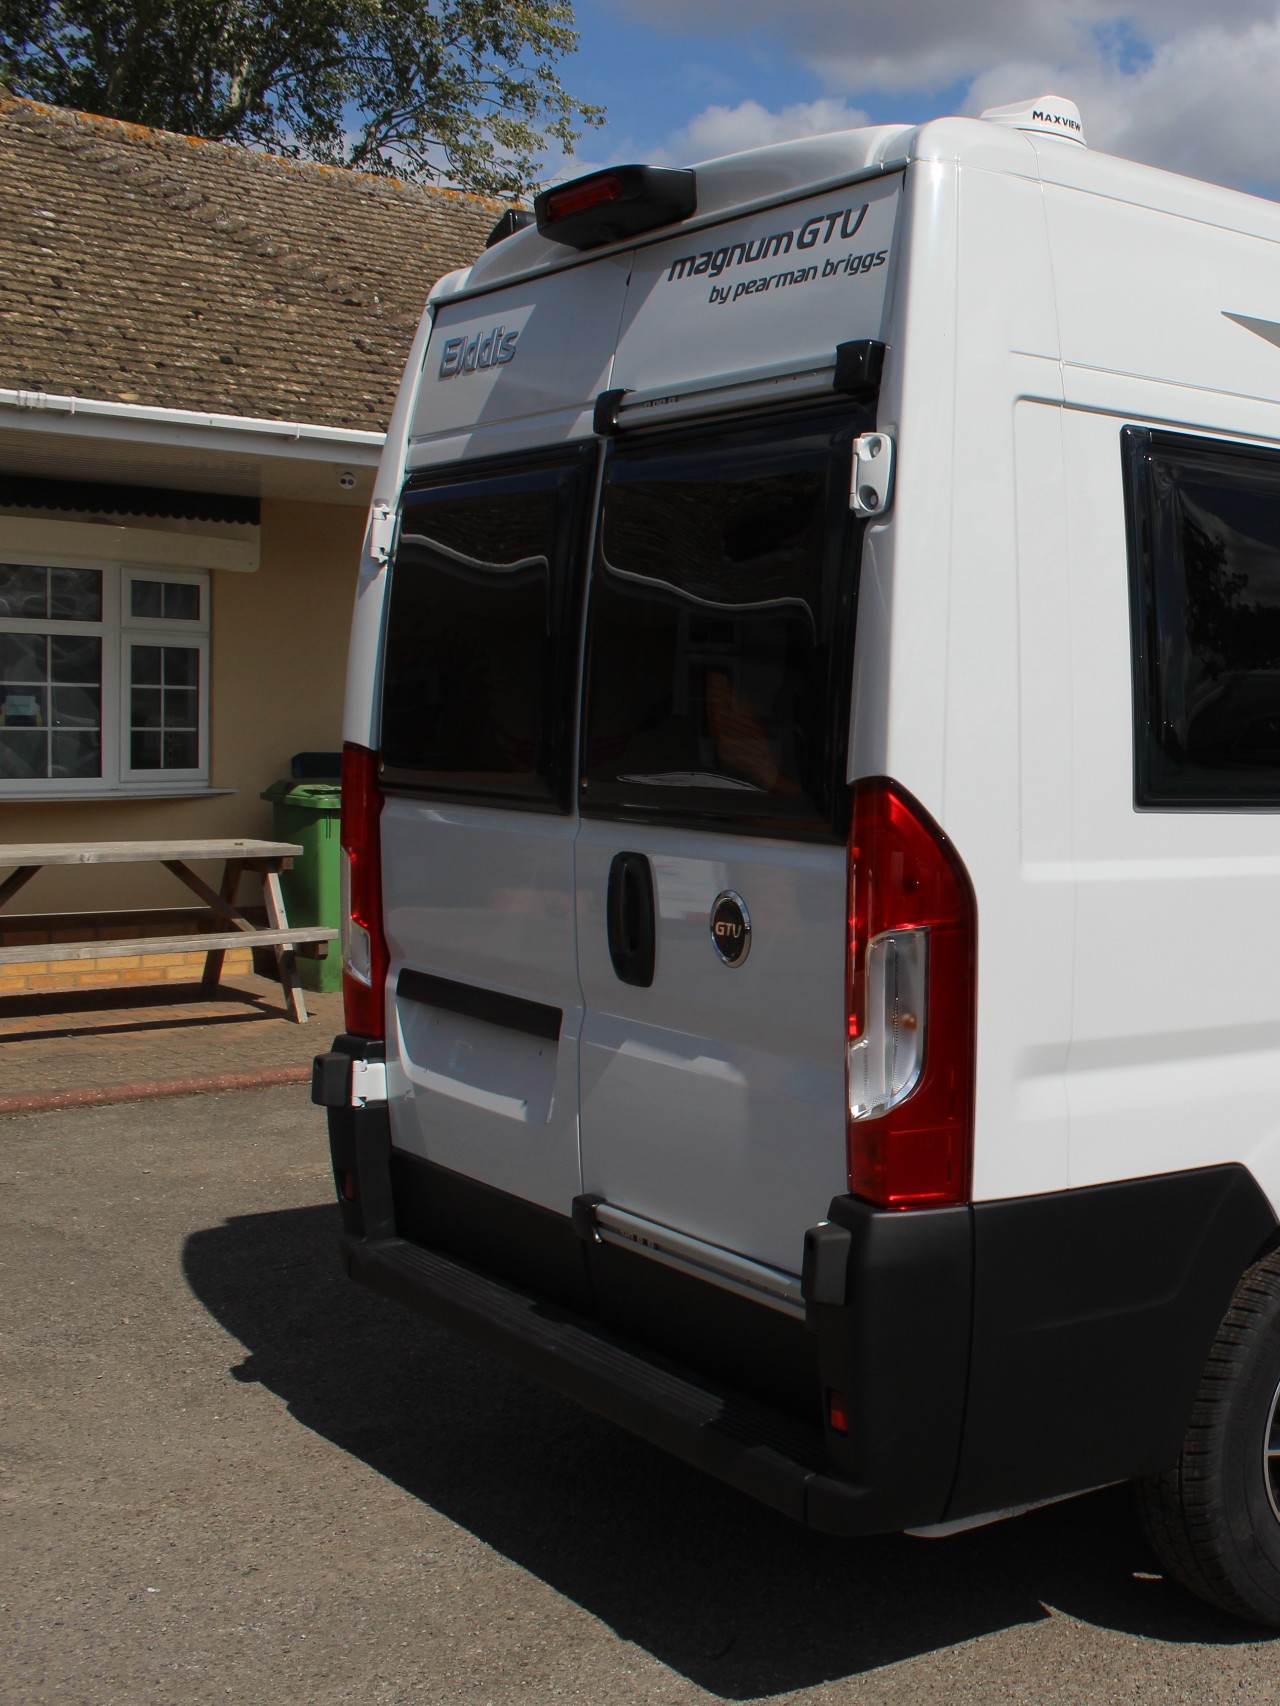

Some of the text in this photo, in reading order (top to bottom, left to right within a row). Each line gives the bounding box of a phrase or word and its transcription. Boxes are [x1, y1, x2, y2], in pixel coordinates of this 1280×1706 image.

[1032, 110, 1081, 132] MAXVIEW
[667, 204, 869, 282] magnum GTV
[708, 250, 888, 305] by pearman briggs
[440, 325, 519, 378] Elddis
[715, 921, 742, 938] GTV
